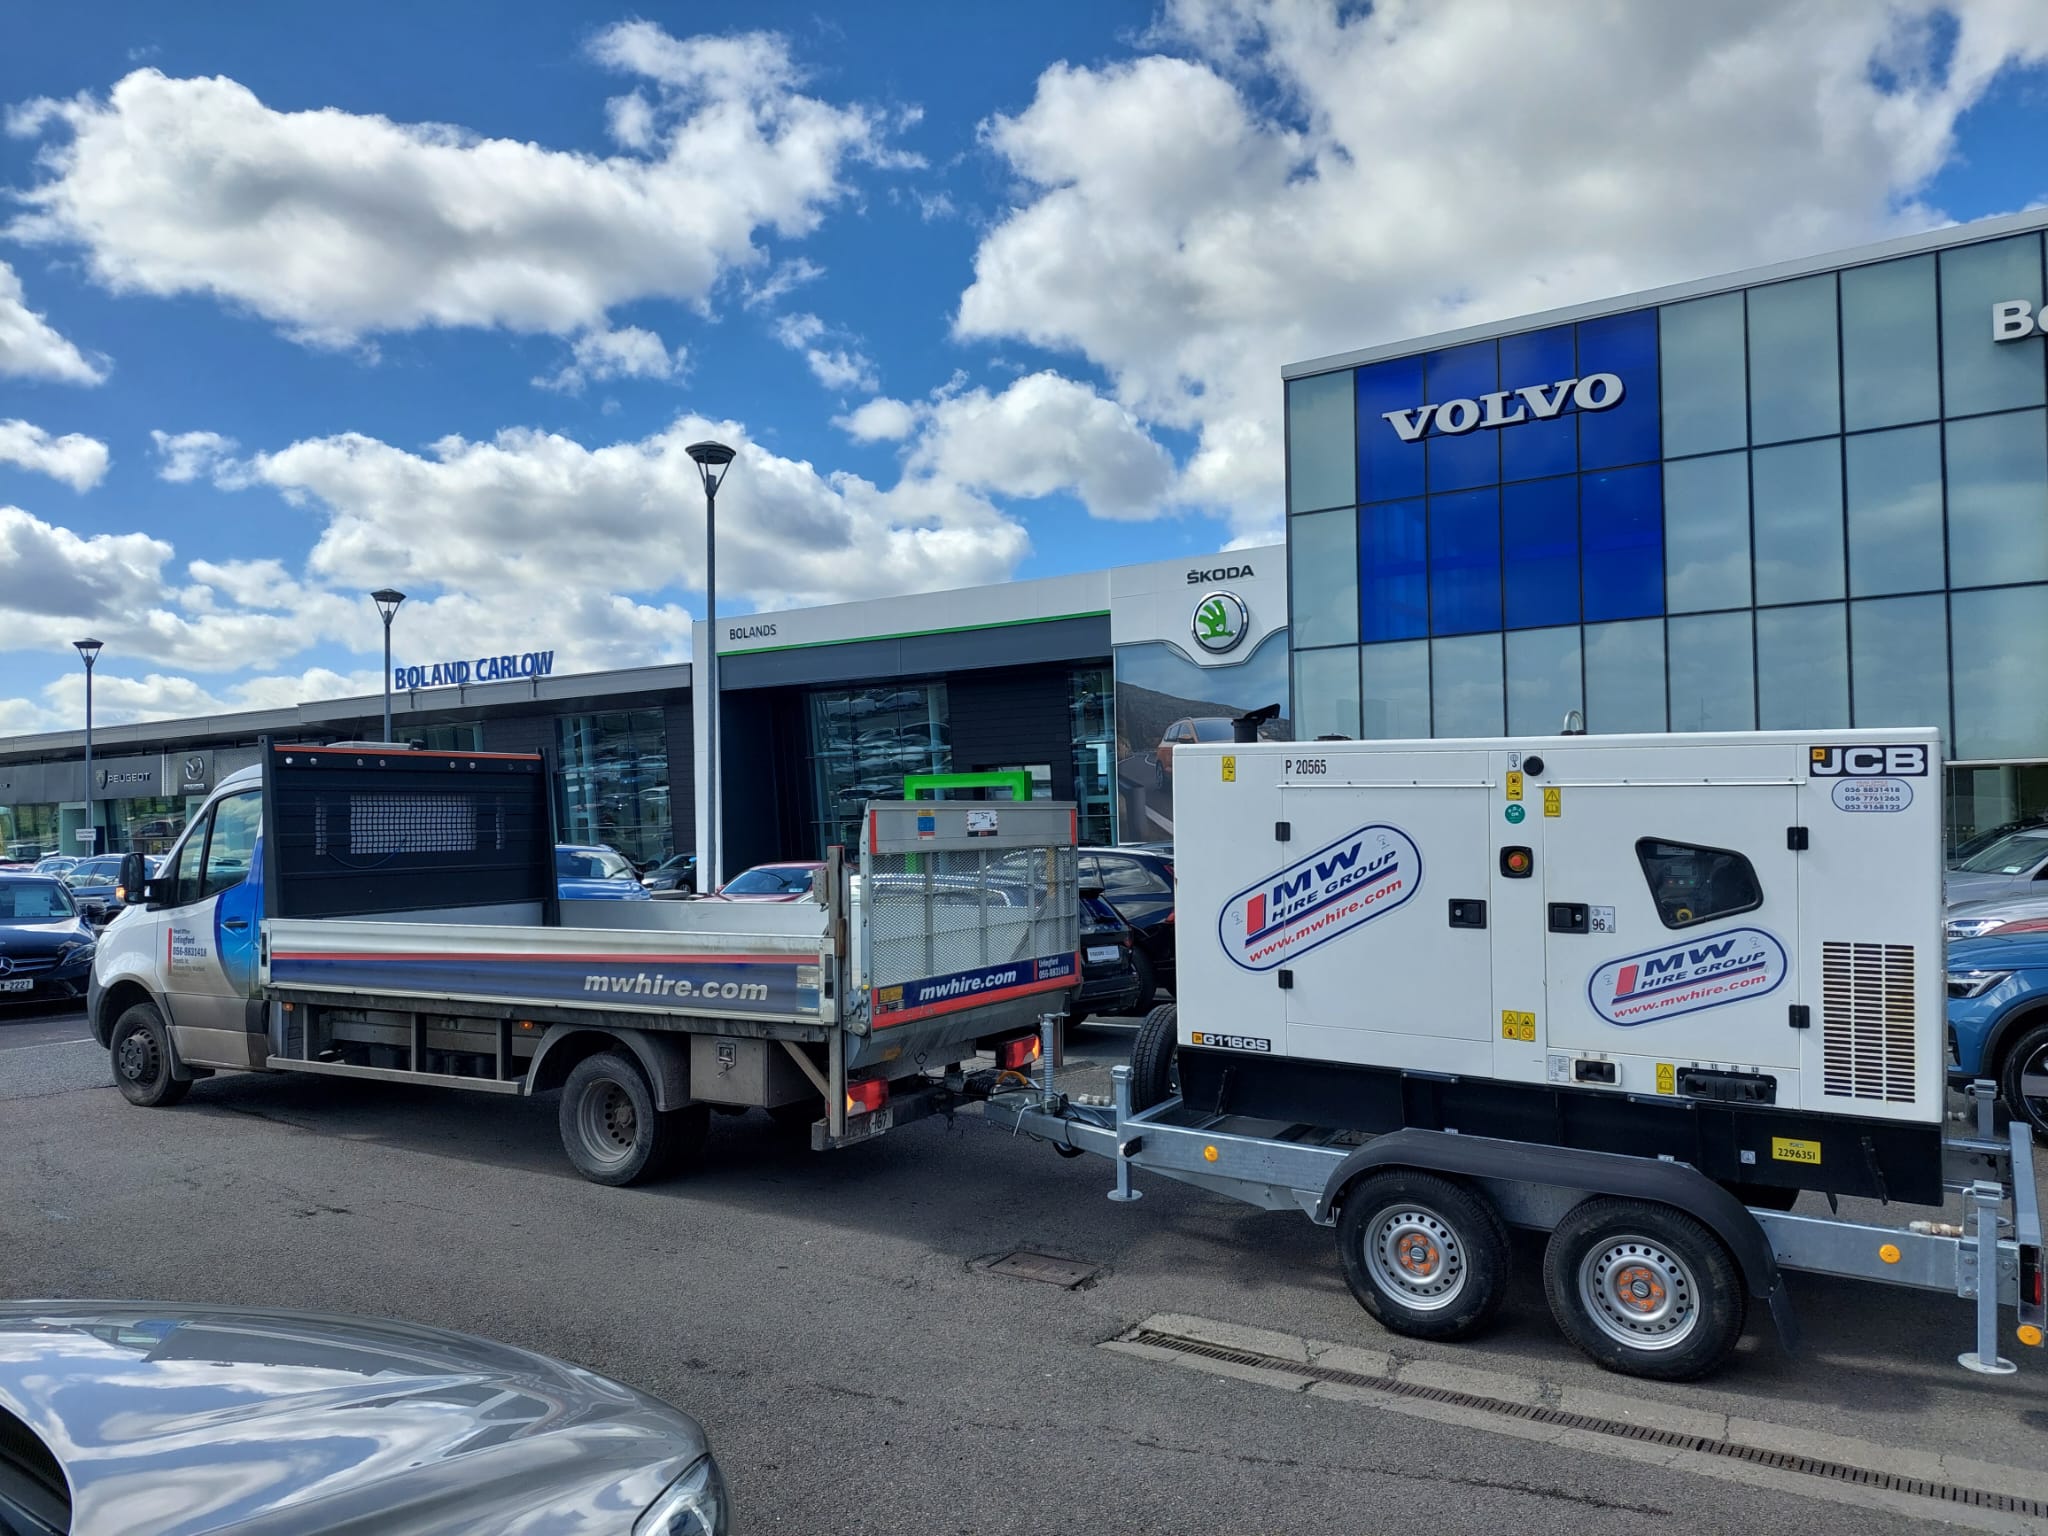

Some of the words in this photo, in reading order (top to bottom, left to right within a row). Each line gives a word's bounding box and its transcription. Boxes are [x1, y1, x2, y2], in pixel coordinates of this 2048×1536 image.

[1993, 300, 2048, 341] B
[1382, 373, 1624, 441] VOLVO
[1186, 565, 1254, 584] ŠKODA
[730, 624, 777, 640] BOLANDS
[395, 660, 471, 690] BOLAND
[475, 650, 554, 682] CARLOW
[1285, 759, 1292, 775] P
[1296, 759, 1327, 775] 20565
[1812, 747, 1925, 775] JCB
[108, 772, 151, 784] PEUGEOT
[1272, 841, 1362, 907] MW
[1272, 891, 1318, 922] HIRE
[1325, 850, 1396, 894] GROUP
[1249, 880, 1402, 962] www.mwhire.com
[1592, 918, 1605, 931] 96
[1641, 971, 1688, 989] HIRE
[1694, 952, 1766, 975] GROUP
[1644, 939, 1736, 977] MW
[584, 973, 768, 1000] mwhire.com
[919, 969, 1016, 1001] mwhire.com
[1614, 974, 1766, 1018] www.mwhire.com
[1203, 1034, 1269, 1051] G116QS
[1777, 1148, 1816, 1161] 2296351
